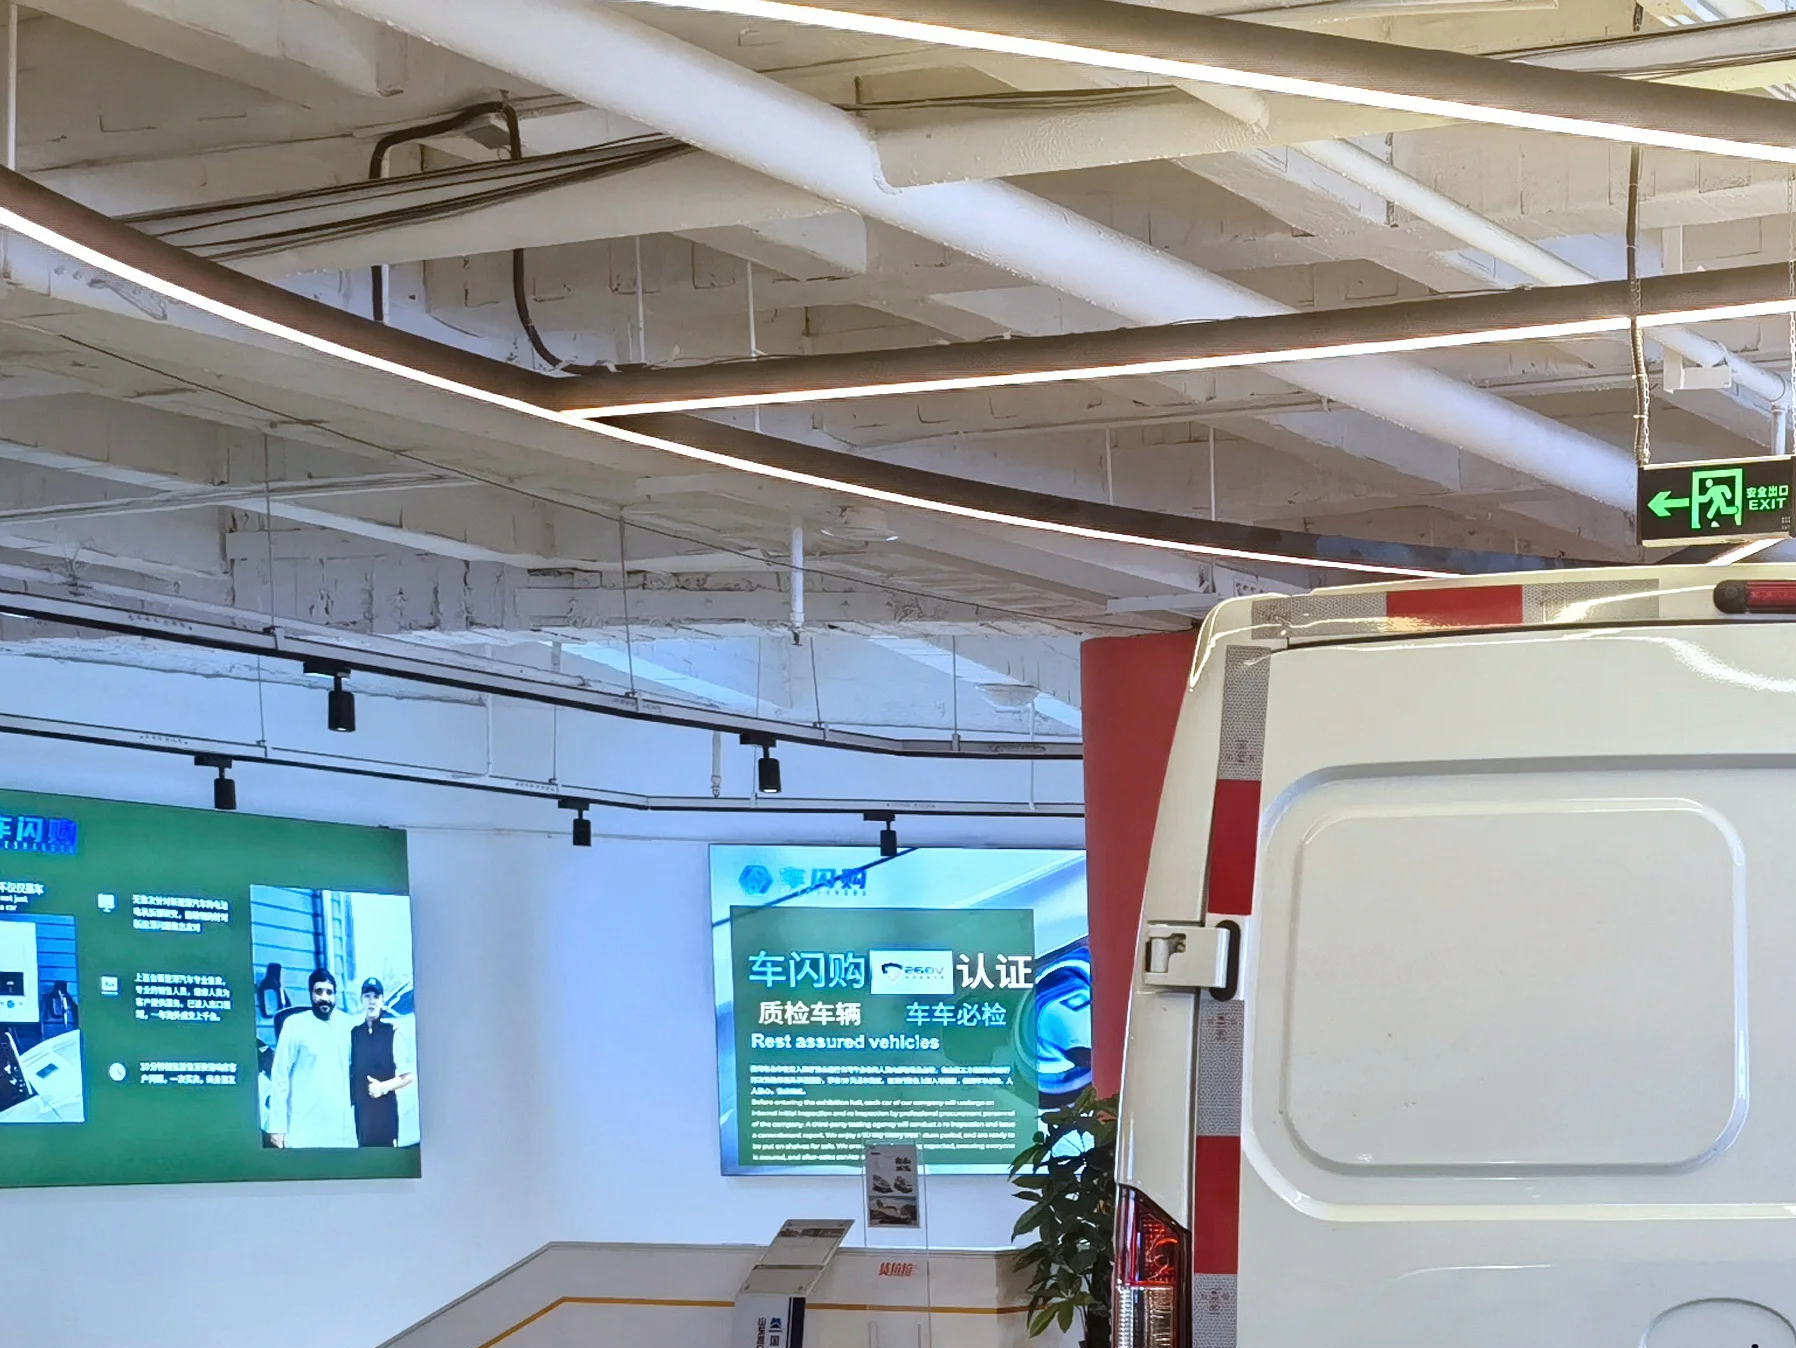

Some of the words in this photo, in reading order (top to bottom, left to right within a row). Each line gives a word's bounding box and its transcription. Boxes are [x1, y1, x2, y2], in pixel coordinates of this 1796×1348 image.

[1746, 485, 1789, 498] 安全出口
[1749, 497, 1787, 510] EXIT
[749, 951, 865, 988] 车闪购
[956, 953, 1034, 989] 认证
[758, 1001, 861, 1026] 质检车辆
[906, 1002, 1007, 1026] 车车必检
[751, 1033, 792, 1049] Rest
[796, 1034, 864, 1049] assured
[869, 1034, 940, 1050] vehicles
